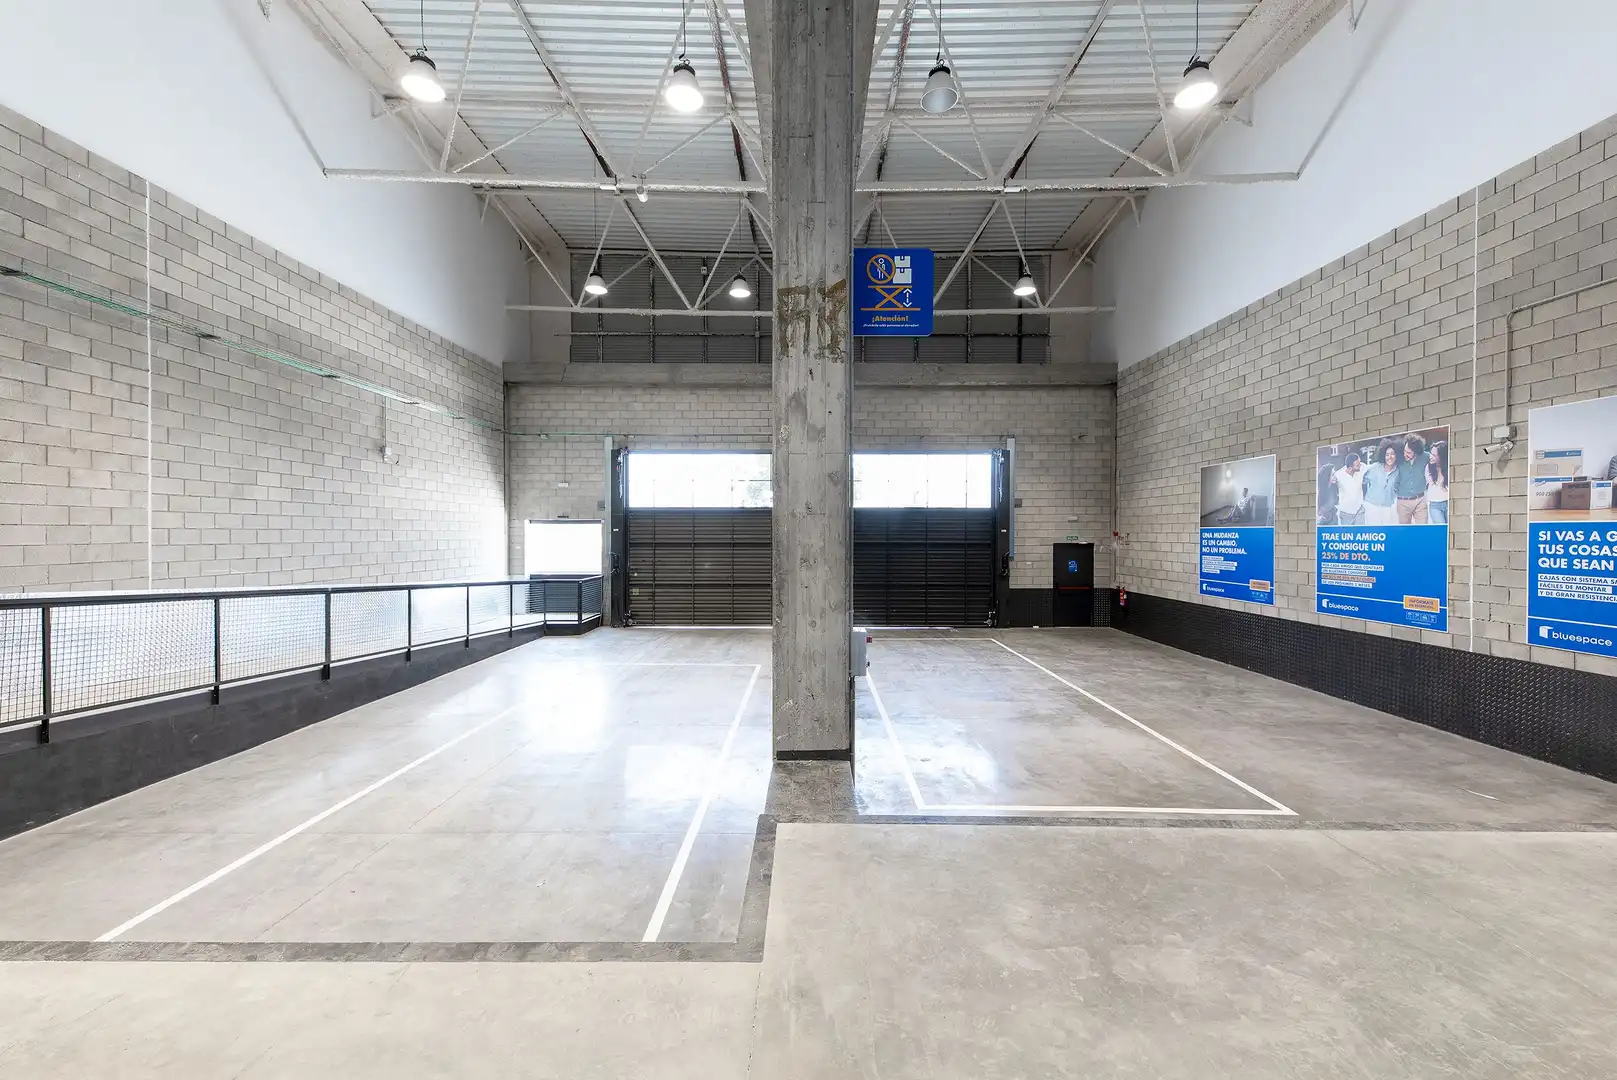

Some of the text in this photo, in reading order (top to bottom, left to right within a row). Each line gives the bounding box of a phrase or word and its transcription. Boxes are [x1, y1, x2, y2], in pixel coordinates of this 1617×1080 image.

[872, 314, 908, 323] ¡Atención!
[1356, 533, 1386, 541] AMIGO
[1538, 530, 1550, 541] SI
[1555, 531, 1584, 541] VAS
[1589, 531, 1601, 542] A
[1328, 543, 1369, 551] CONSIGUE
[1371, 544, 1385, 552] UN
[1538, 544, 1564, 555] TUS
[1351, 553, 1371, 561] DTO.
[1538, 558, 1614, 571] QUE SEAN
[1329, 603, 1359, 612] bluespace
[1552, 631, 1612, 646] bluespace
